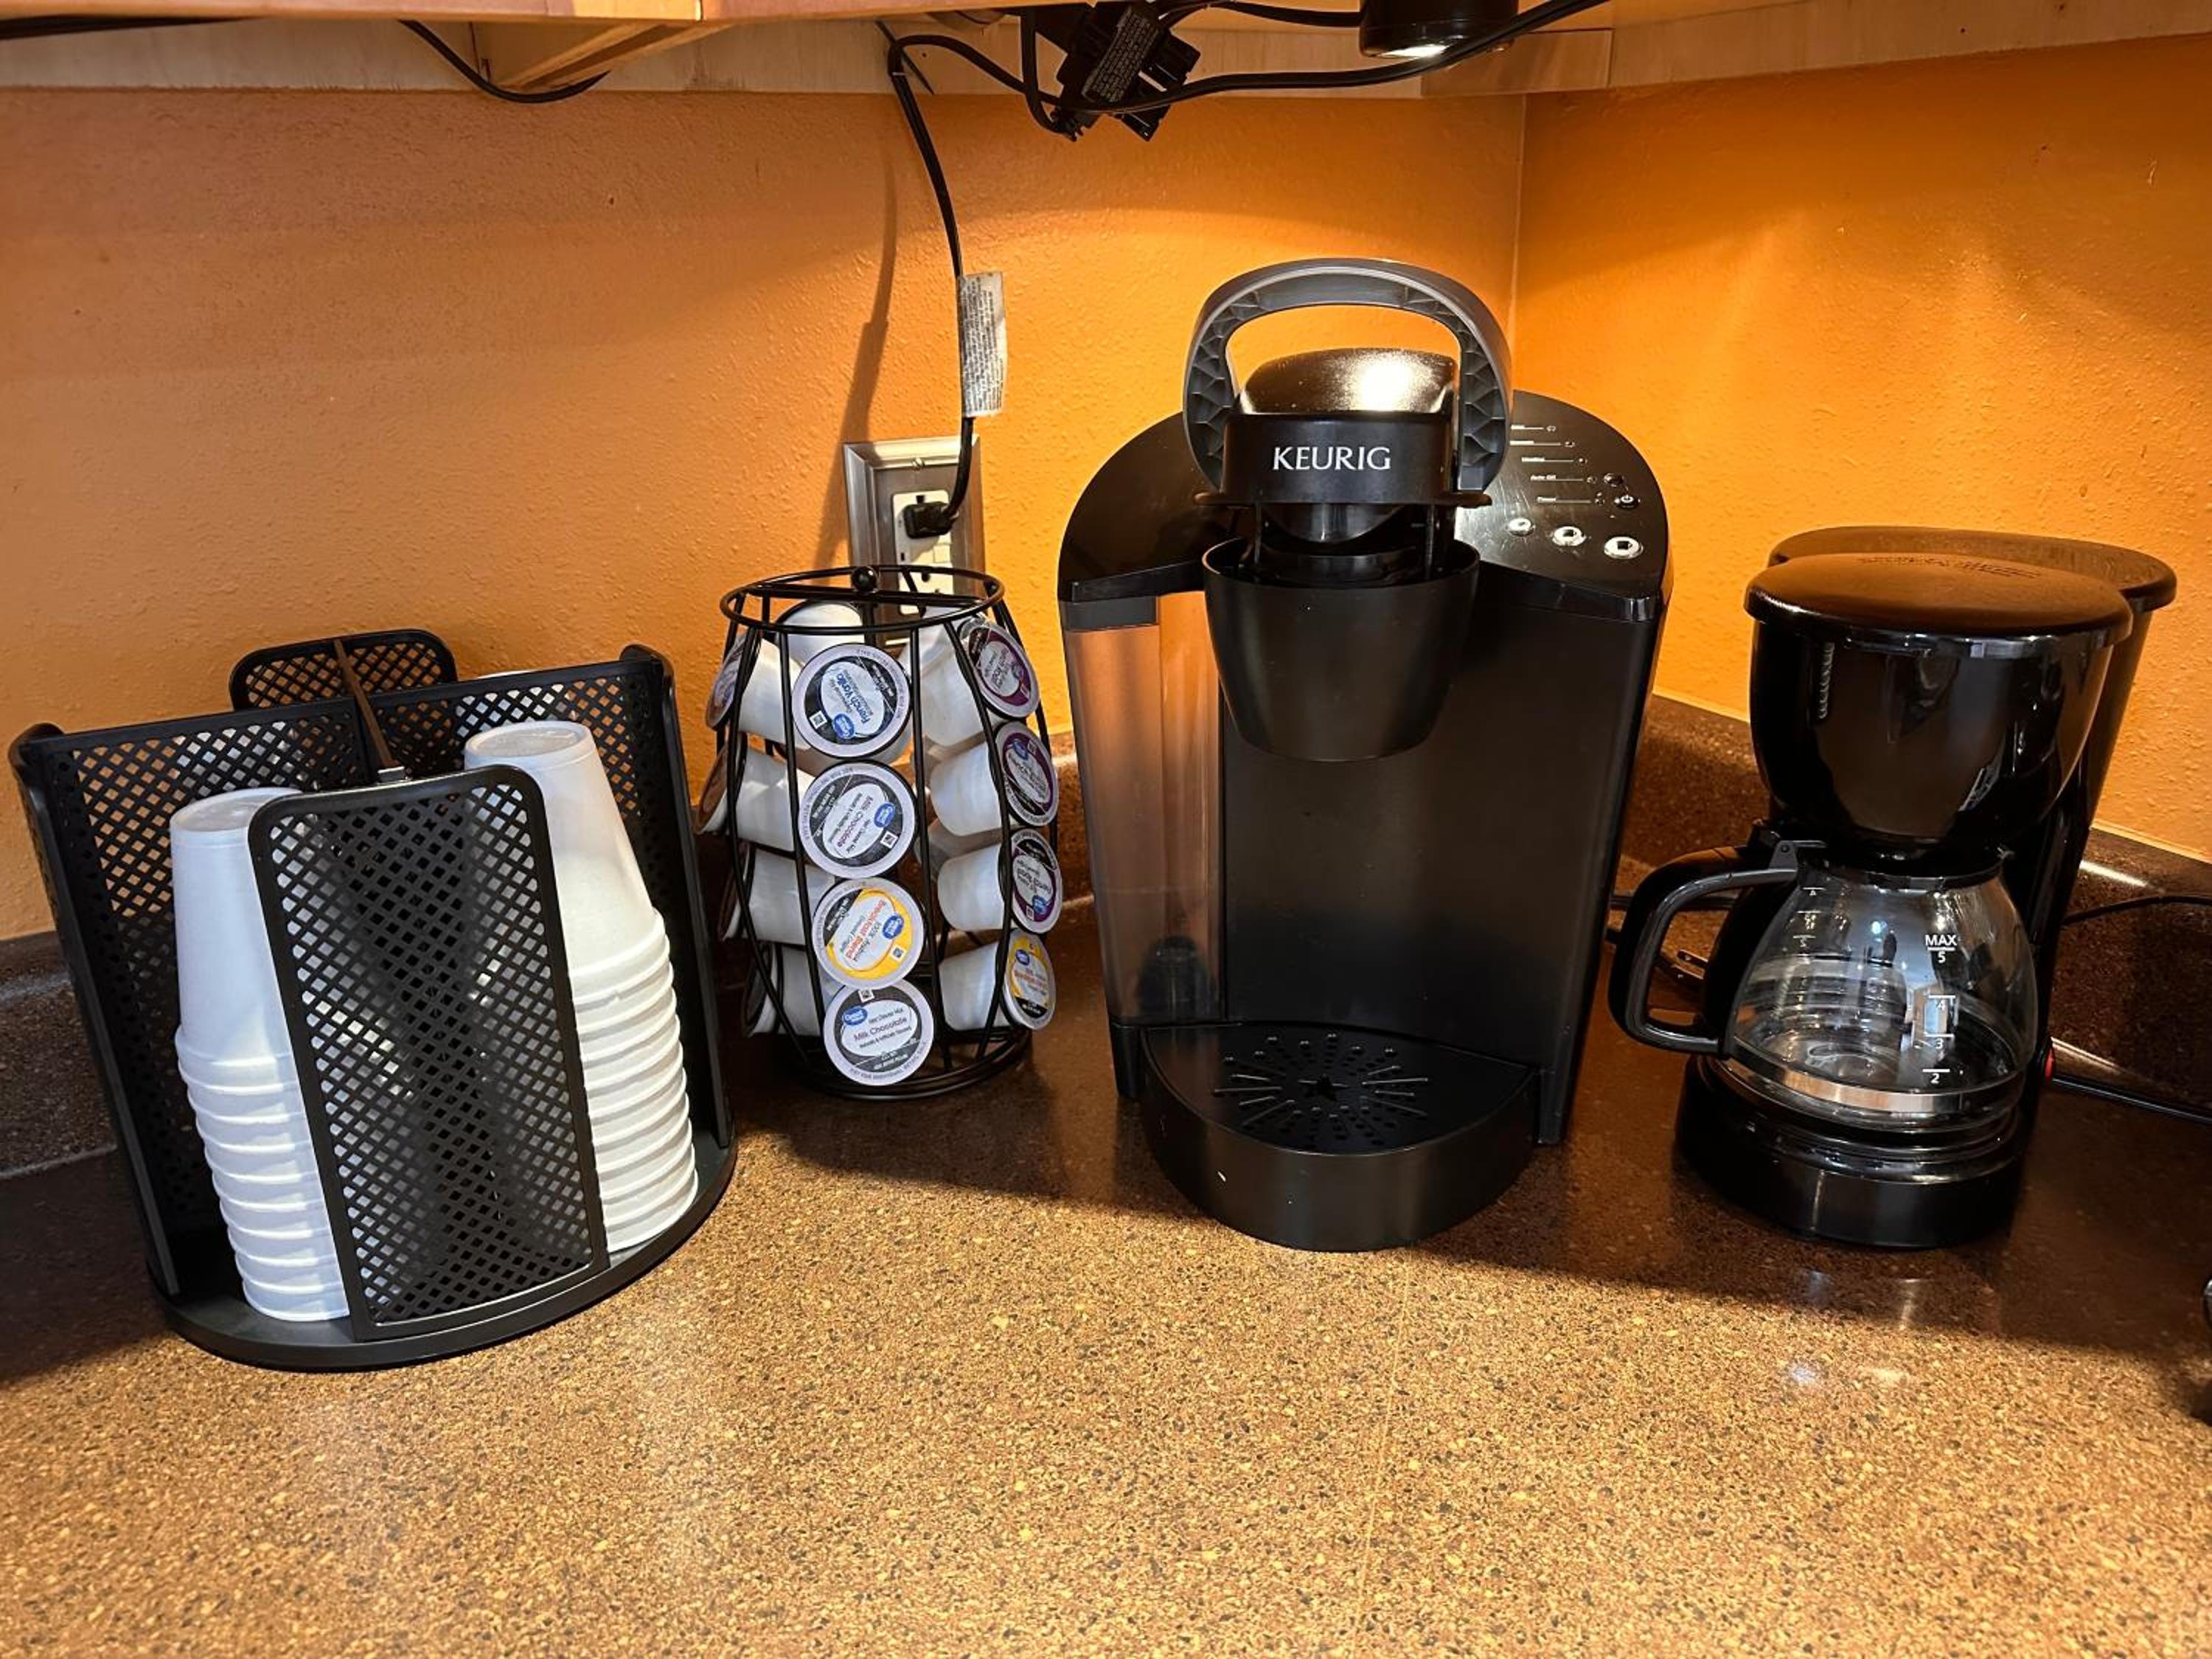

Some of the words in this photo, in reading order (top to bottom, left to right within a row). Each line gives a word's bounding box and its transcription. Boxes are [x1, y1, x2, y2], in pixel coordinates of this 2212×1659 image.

[1273, 446, 1391, 470] KEURIG
[833, 672, 855, 698] Vanilla
[847, 695, 871, 725] French
[836, 810, 864, 848] Chocolate
[1925, 934, 1957, 946] MAX
[1938, 951, 1946, 964] 5
[1936, 1000, 1945, 1011] 4
[869, 1016, 908, 1034] Chocolate
[1935, 1038, 1944, 1049] 3
[1930, 1073, 1939, 1084] 2
